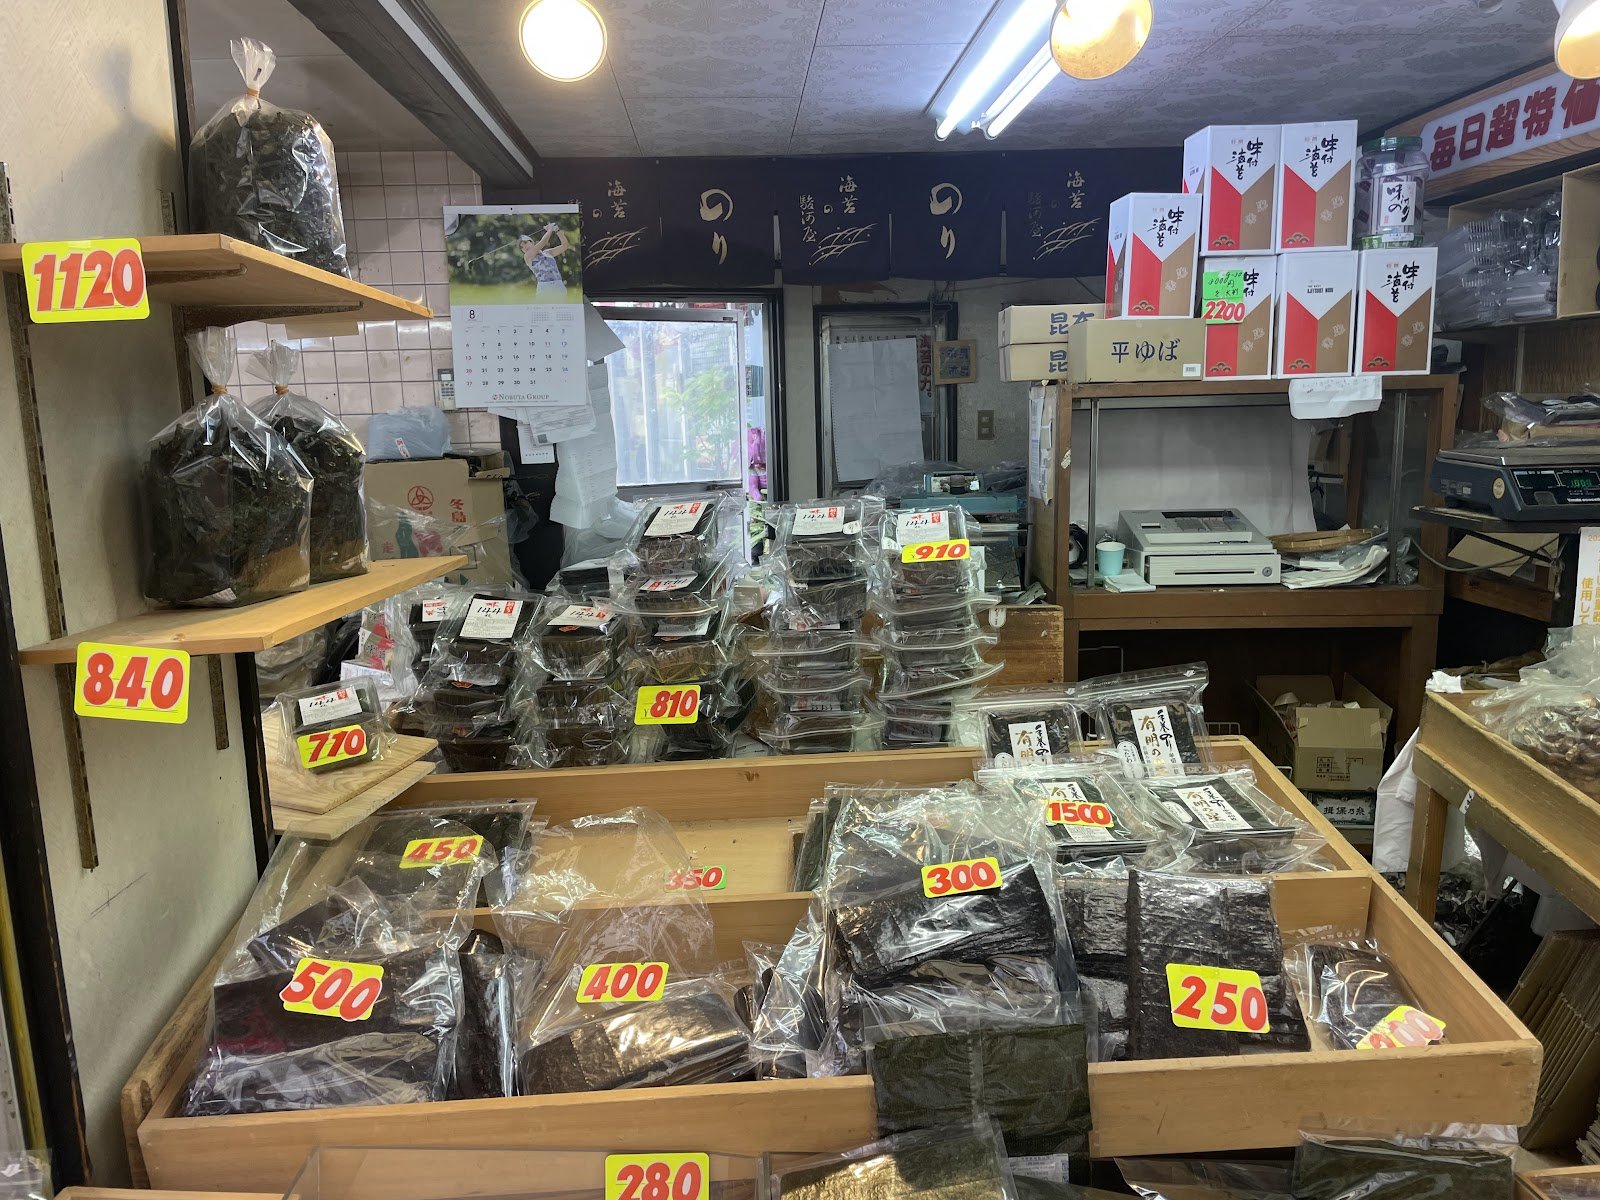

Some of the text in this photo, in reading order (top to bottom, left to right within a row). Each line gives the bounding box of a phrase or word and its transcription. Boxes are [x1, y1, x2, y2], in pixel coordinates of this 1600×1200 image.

[1430, 78, 1600, 172] 毎日超特価
[1247, 137, 1263, 167] 味付
[1321, 134, 1338, 164] 味付
[592, 179, 627, 218] 海苔 の
[839, 175, 858, 213] 海苔
[1067, 171, 1085, 208] 海苔
[823, 204, 834, 214] の
[930, 183, 962, 259] のり
[1168, 206, 1184, 235] 味付
[700, 189, 734, 265] のり
[33, 249, 145, 312] 1120
[1243, 268, 1259, 297] 味付
[1402, 261, 1419, 290] 味付
[469, 309, 476, 320] 8
[1201, 300, 1245, 321] 2200
[1049, 350, 1068, 372] 昆
[1111, 338, 1180, 363] 平ゆば
[916, 544, 966, 559] 910
[82, 652, 184, 709] 840
[650, 690, 698, 717] 810
[309, 729, 365, 762] 710
[1049, 803, 1111, 825] 1500
[408, 838, 479, 860] 450
[664, 867, 723, 890] 350
[926, 861, 997, 895] 300
[282, 962, 382, 1020] 500
[584, 966, 664, 1000] 400
[1172, 976, 1269, 1031] 250
[616, 1162, 702, 1200] 280
